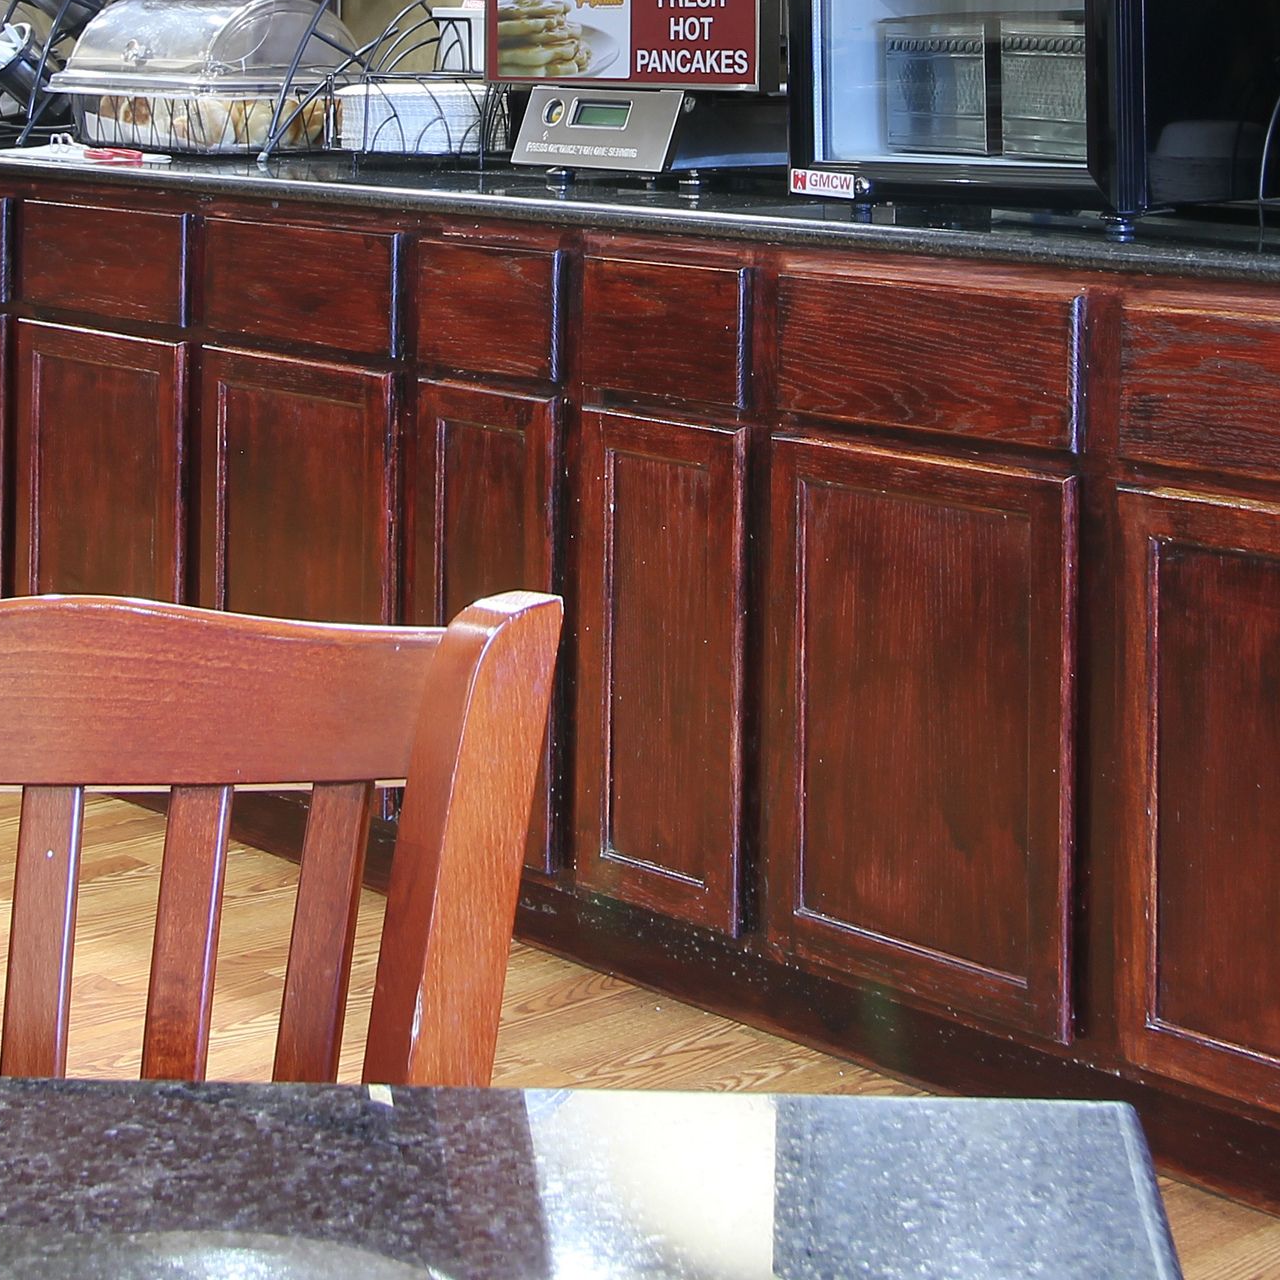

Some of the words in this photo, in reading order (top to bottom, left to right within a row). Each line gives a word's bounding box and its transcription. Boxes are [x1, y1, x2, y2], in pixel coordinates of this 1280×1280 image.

[669, 17, 714, 40] HOT
[636, 49, 748, 74] PANCAKES
[809, 172, 852, 191] GMCW
